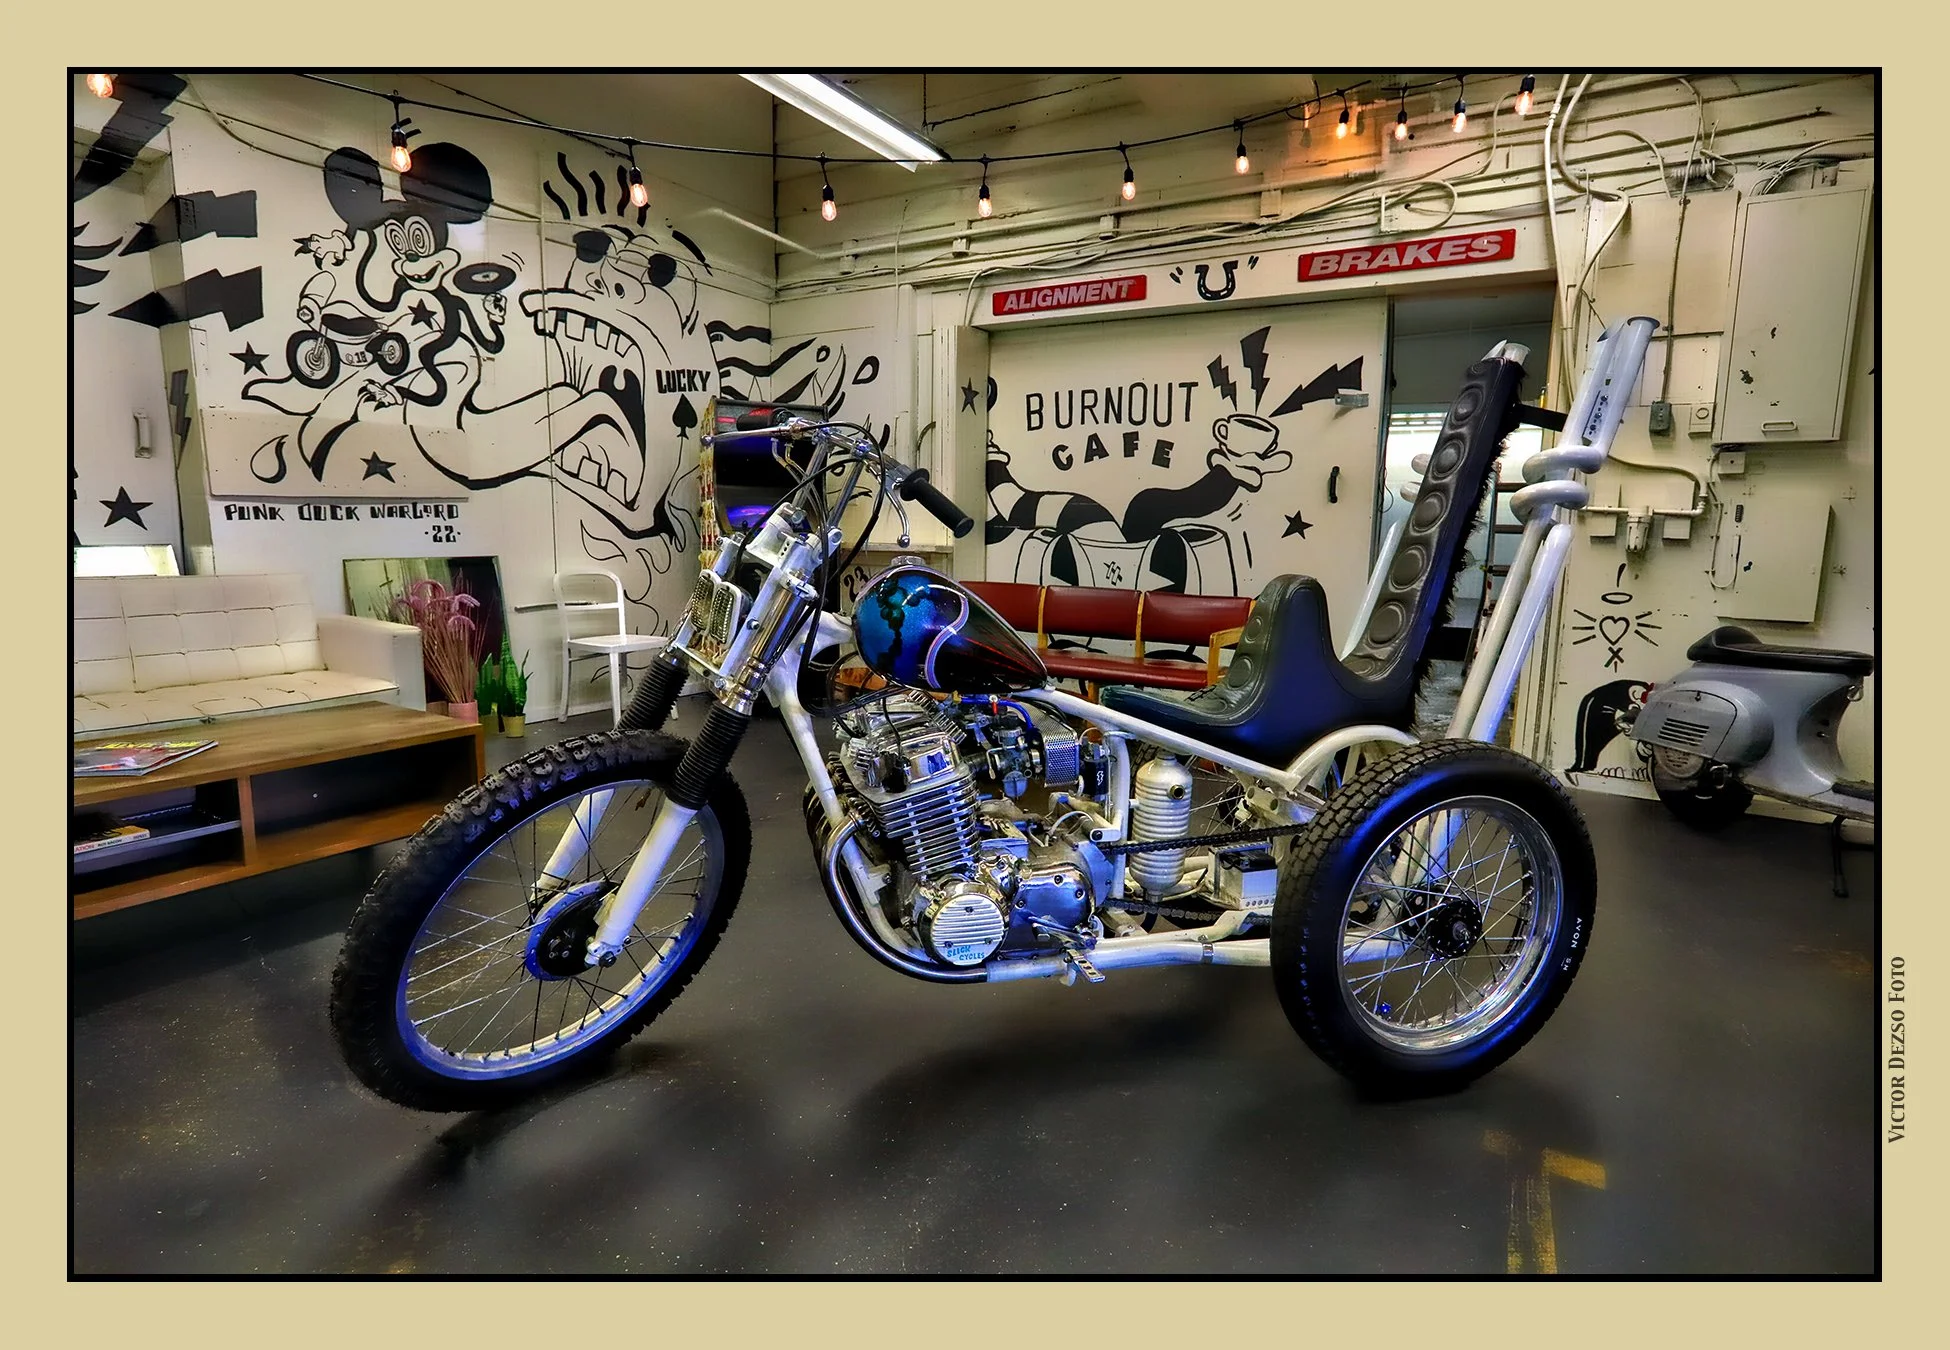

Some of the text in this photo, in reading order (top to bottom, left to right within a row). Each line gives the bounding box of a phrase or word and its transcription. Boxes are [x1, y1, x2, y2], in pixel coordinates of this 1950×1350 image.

[1308, 235, 1503, 277] BRAKES
[1003, 279, 1137, 312] ALIGNMENT
[656, 369, 711, 394] LUCKY
[1026, 382, 1199, 431] BURNOUT
[1052, 431, 1175, 471] CAFE
[224, 503, 285, 521] PUNK
[298, 503, 360, 521] DUCK
[1571, 917, 1583, 948] AVON
[959, 952, 985, 960] CYCLES
